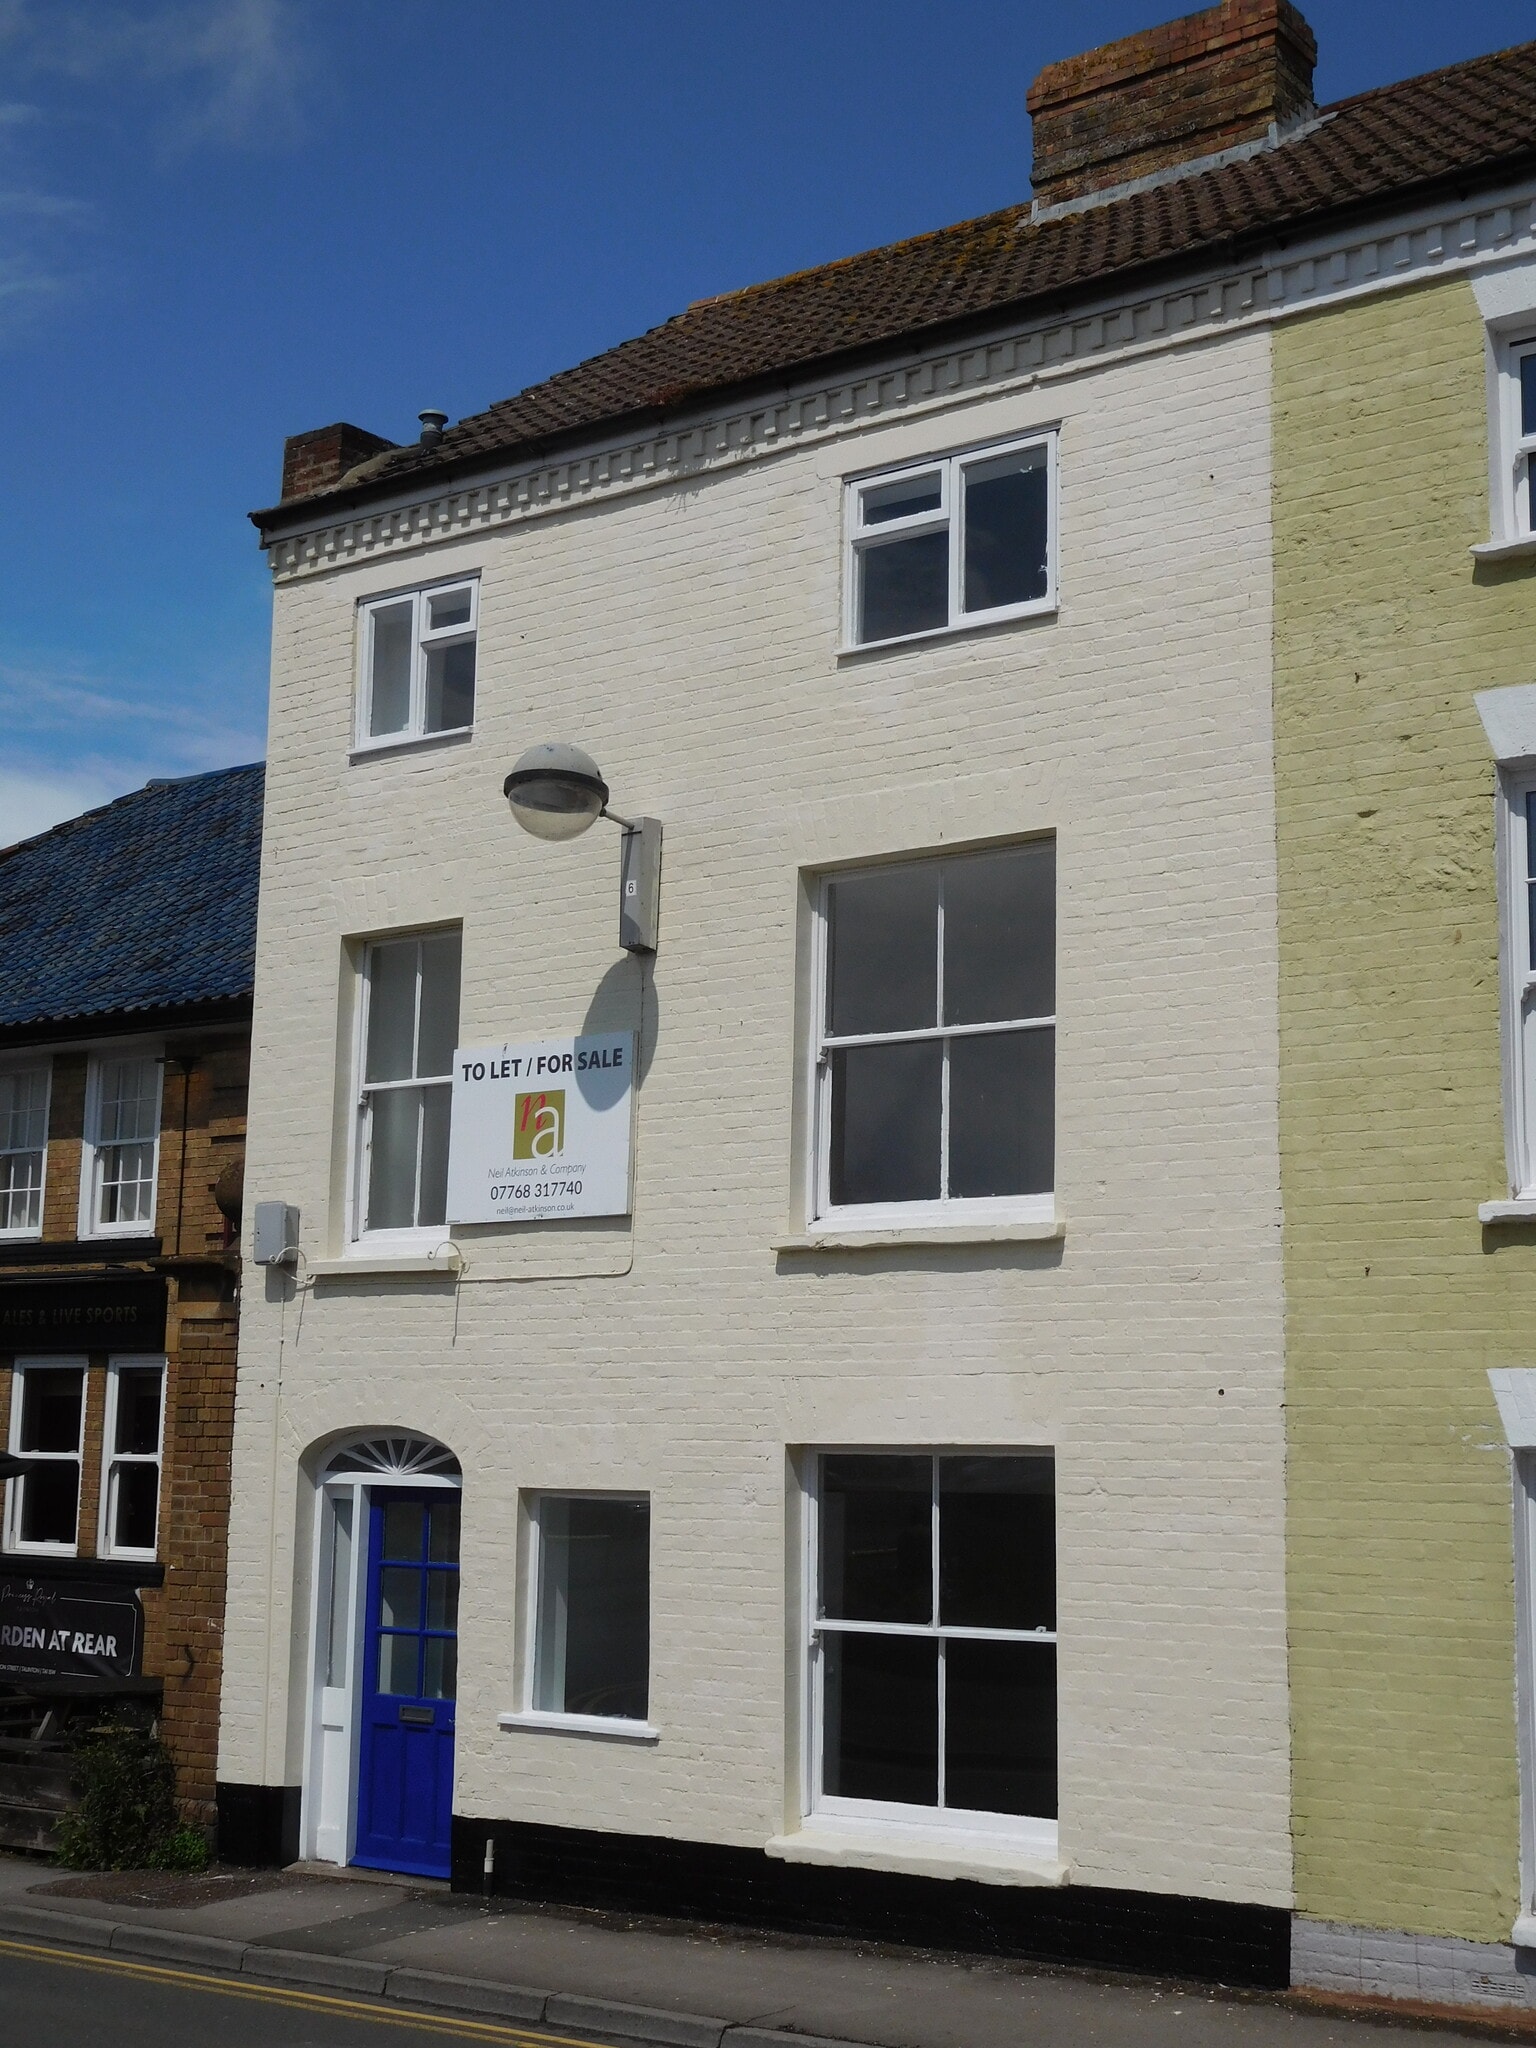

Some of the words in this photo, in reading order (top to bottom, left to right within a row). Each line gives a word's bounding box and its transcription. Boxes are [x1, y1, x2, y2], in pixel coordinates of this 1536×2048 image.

[628, 882, 634, 894] 6
[462, 1062, 485, 1082] TO
[490, 1058, 522, 1079] LET
[537, 1053, 573, 1075] FOR
[577, 1047, 623, 1071] SALE
[488, 1166, 504, 1179] Neil
[505, 1164, 538, 1177] Atkinson
[541, 1164, 548, 1175] &
[550, 1163, 587, 1176] Company
[490, 1183, 531, 1200] 07768
[534, 1180, 583, 1198] 317740
[496, 1202, 575, 1216] neil@neil-atkinson.co.uk
[2, 1309, 33, 1326] ALES
[38, 1309, 47, 1325] &
[53, 1307, 81, 1325] LIVE
[86, 1306, 138, 1324] SPORTS
[48, 1629, 71, 1651] AT
[72, 1632, 118, 1658] REAR
